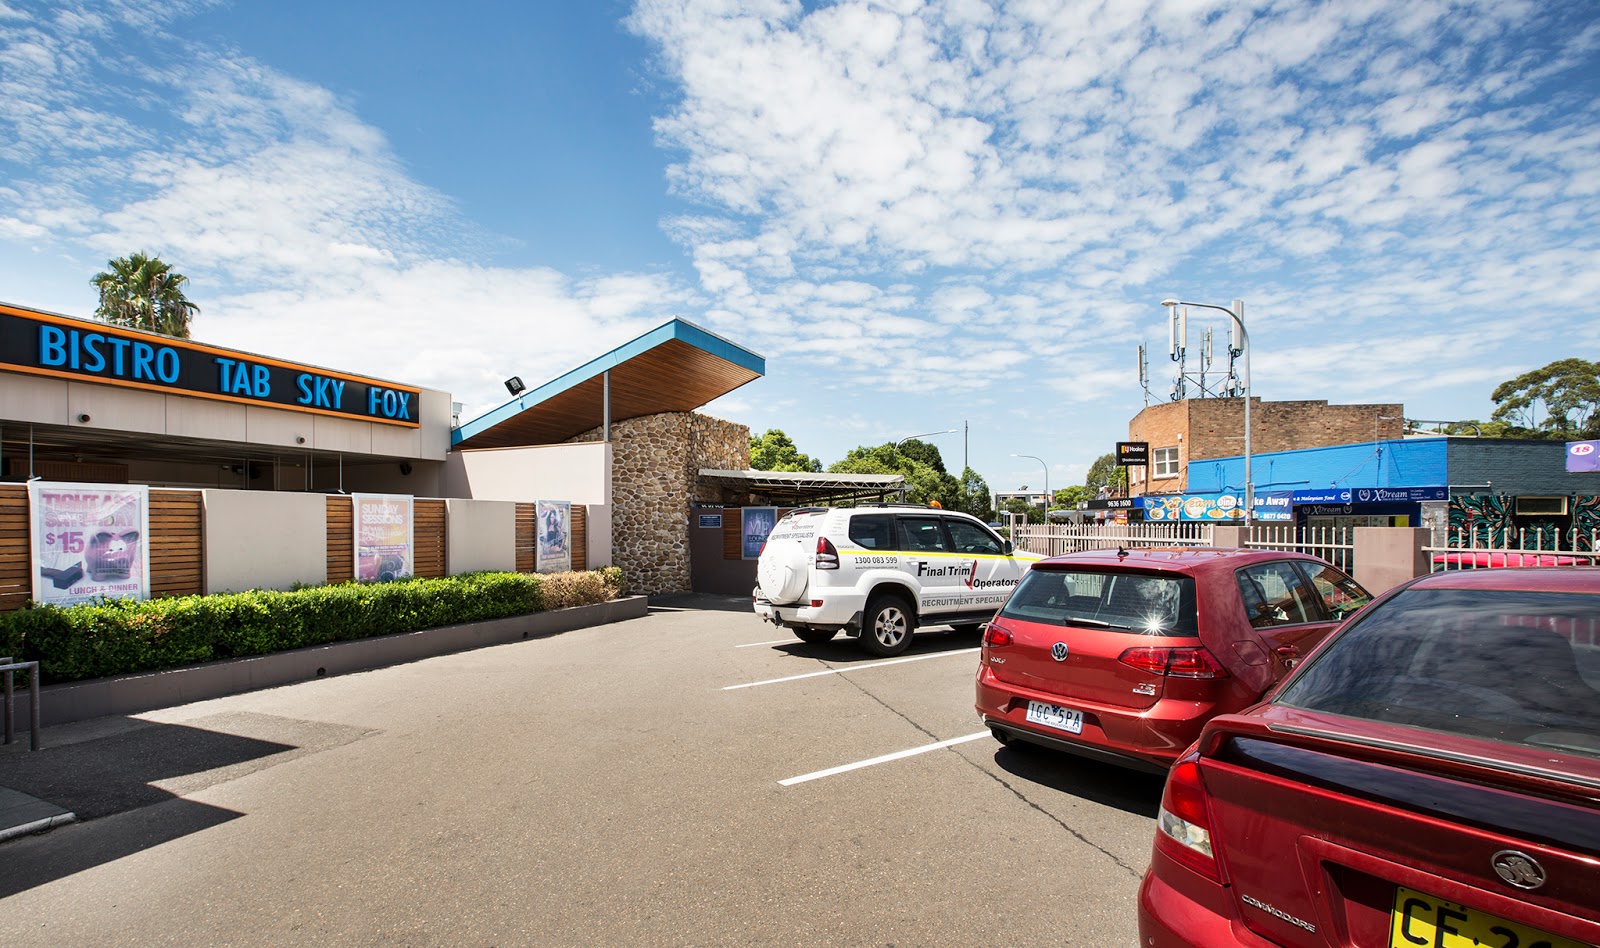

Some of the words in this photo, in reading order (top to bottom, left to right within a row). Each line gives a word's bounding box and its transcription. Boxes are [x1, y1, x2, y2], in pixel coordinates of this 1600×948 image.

[39, 325, 180, 384] BISTRO
[215, 357, 271, 398] TAB
[296, 373, 345, 409] SKY
[367, 386, 410, 420] FOX
[1372, 490, 1408, 501] XDream
[1237, 497, 1244, 506] &
[1266, 497, 1290, 507] Away
[362, 504, 399, 515] SUNDAY
[362, 514, 403, 525] SESSIONS
[45, 532, 84, 554] $15
[854, 556, 871, 564] 1300
[872, 556, 884, 564] 083
[885, 556, 898, 564] 599
[917, 562, 946, 577] Final
[948, 566, 970, 576] Trim
[69, 586, 97, 595] LUNCH
[109, 583, 138, 592] DINNER
[973, 578, 1019, 590] Operators
[922, 597, 973, 607] RECRUITMENT
[975, 596, 1006, 604] SPECIALI
[1058, 709, 1080, 728] 5PA
[1241, 894, 1316, 933] COMMODORE
